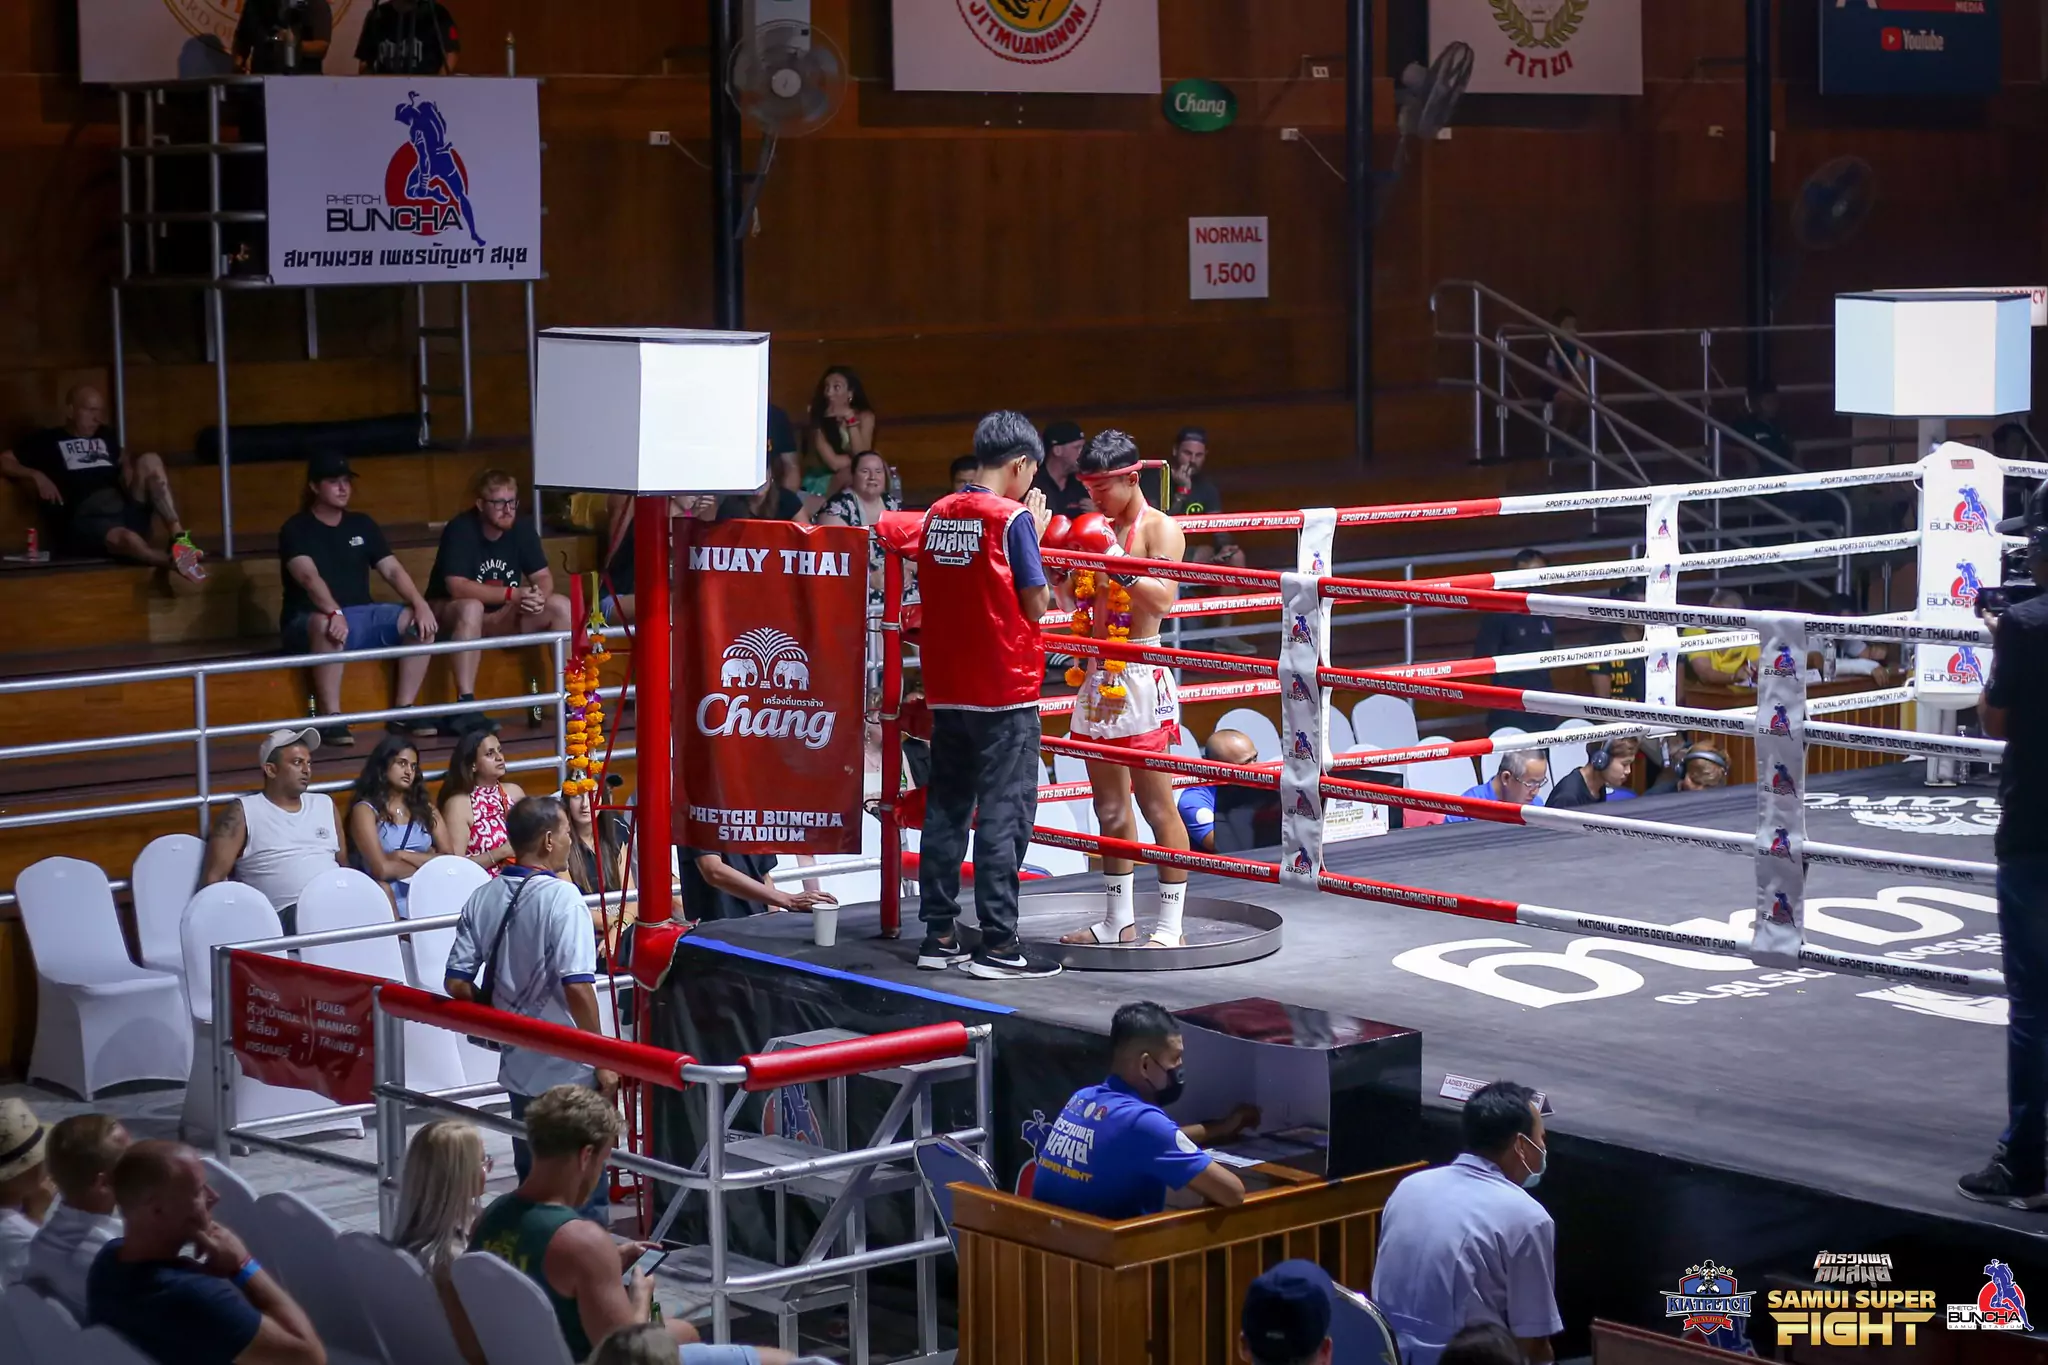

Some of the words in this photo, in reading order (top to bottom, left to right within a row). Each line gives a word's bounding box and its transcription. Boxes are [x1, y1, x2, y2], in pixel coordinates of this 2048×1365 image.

[969, 1, 1088, 55] JITMUANGNON
[1902, 30, 1944, 51] YouTube
[1173, 92, 1227, 118] Chang
[326, 194, 381, 205] PHETCH
[326, 207, 463, 232] BUNCHA
[1195, 226, 1263, 244] NORMAL
[1203, 262, 1256, 286] 1,500
[1545, 499, 1571, 508] SPORTS
[1572, 497, 1608, 506] AUTHORITY
[1620, 493, 1652, 502] THAILAND
[1207, 517, 1251, 528] AUTHORITY
[1251, 517, 1261, 526] OF
[1263, 516, 1300, 525] THAILAND
[1340, 512, 1369, 522] SPORTS
[1370, 510, 1411, 520] AUTHORITY
[1411, 509, 1421, 518] OF
[1422, 507, 1457, 516] THAILAND
[1930, 522, 1984, 531] BUNCHA
[689, 546, 770, 573] MUAY
[779, 549, 851, 577] THAI
[1148, 567, 1180, 578] SPORTS
[1180, 570, 1225, 583] AUTHORITY
[1226, 575, 1236, 584] OF
[1238, 576, 1280, 589] THAILAND
[1202, 600, 1228, 611] SPORTS
[1228, 597, 1273, 609] DEVELOPMENT
[1324, 585, 1360, 596] SPORTS
[1360, 588, 1409, 600] AUTHORITY
[1410, 592, 1421, 601] OF
[1423, 593, 1469, 605] THAILAND
[1927, 597, 1976, 606] BUNCH
[1588, 606, 1625, 618] SPORTS
[1627, 609, 1680, 623] AUTHORITY
[1682, 613, 1694, 623] OF
[1698, 614, 1746, 626] THAILAND
[1804, 621, 1845, 634] SPORTS
[1848, 624, 1907, 637] AUTHORITY
[1909, 627, 1922, 638] OF
[1926, 628, 1980, 641] THAILAND
[1142, 652, 1174, 664] NATIONAL
[1175, 656, 1202, 668] SPORTS
[1202, 659, 1252, 674] DEVELOPMENT
[1253, 665, 1273, 675] FUND
[1540, 654, 1565, 664] SPORTS
[1566, 650, 1602, 661] AUTHORITY
[1604, 649, 1613, 658] OF
[1614, 646, 1646, 656] THAILAND
[1176, 687, 1200, 698] PORTS
[1201, 685, 1244, 696] AUTHORITY
[1256, 680, 1281, 692] THAIL
[1320, 673, 1356, 687] NATIONAL
[1357, 677, 1385, 690] SPORTS
[1386, 681, 1441, 697] DEVELOPMENT
[1442, 688, 1463, 700] FUND
[696, 693, 837, 750] Chang
[1584, 705, 1624, 718] NATIONAL
[1625, 709, 1657, 721] SPORTS
[1658, 712, 1719, 729] DEVELOPMENT
[1720, 719, 1744, 730] FUND
[1804, 728, 1848, 743] NATIONAL
[1849, 733, 1885, 746] SPORTS
[1886, 737, 1954, 754] DEVELOPMENT
[1955, 744, 1981, 756] FUND
[1363, 754, 1388, 765] SPORTS
[1388, 750, 1432, 763] DEVELOPMENT
[1432, 747, 1449, 758] FUND
[1144, 758, 1176, 770] SPORTS
[1177, 763, 1221, 777] AUTHORITY
[1222, 769, 1232, 778] OF
[1233, 769, 1274, 784] THAILAND
[1320, 782, 1353, 796] SPORTS
[1354, 788, 1403, 805] AUTHORITY
[1405, 797, 1416, 806] OF
[1418, 799, 1465, 813] THAILAND
[688, 806, 757, 826] PHETCH
[762, 810, 844, 828] BUNCHA
[718, 826, 806, 842] STADIUM
[1582, 823, 1619, 836] SPORTS
[1623, 829, 1676, 843] AUTHORITY
[1677, 837, 1690, 846] OF
[1691, 838, 1743, 852] THAILAND
[1141, 848, 1174, 862] NATIONAL
[1174, 853, 1200, 866] SPORTS
[1200, 858, 1250, 874] DEVELOPMENT
[1250, 865, 1271, 876] FUND
[1843, 857, 1900, 872] AUTHORITY
[1903, 865, 1918, 874] OF
[1919, 866, 1975, 881] THAILAND
[1353, 882, 1381, 896] SPORTS
[1382, 887, 1436, 906] DEVELOPMENT
[1437, 896, 1458, 908] FUND
[1578, 918, 1617, 934] NATIONAL
[1618, 924, 1649, 938] SPORTS
[1651, 928, 1711, 948] DEVELOPMENT
[1712, 938, 1736, 950] FUND
[1839, 958, 1874, 973] SPORTS
[1875, 963, 1942, 982] DEVELOPMENT
[1943, 973, 1969, 986] FUND
[316, 1000, 345, 1016] BOXER
